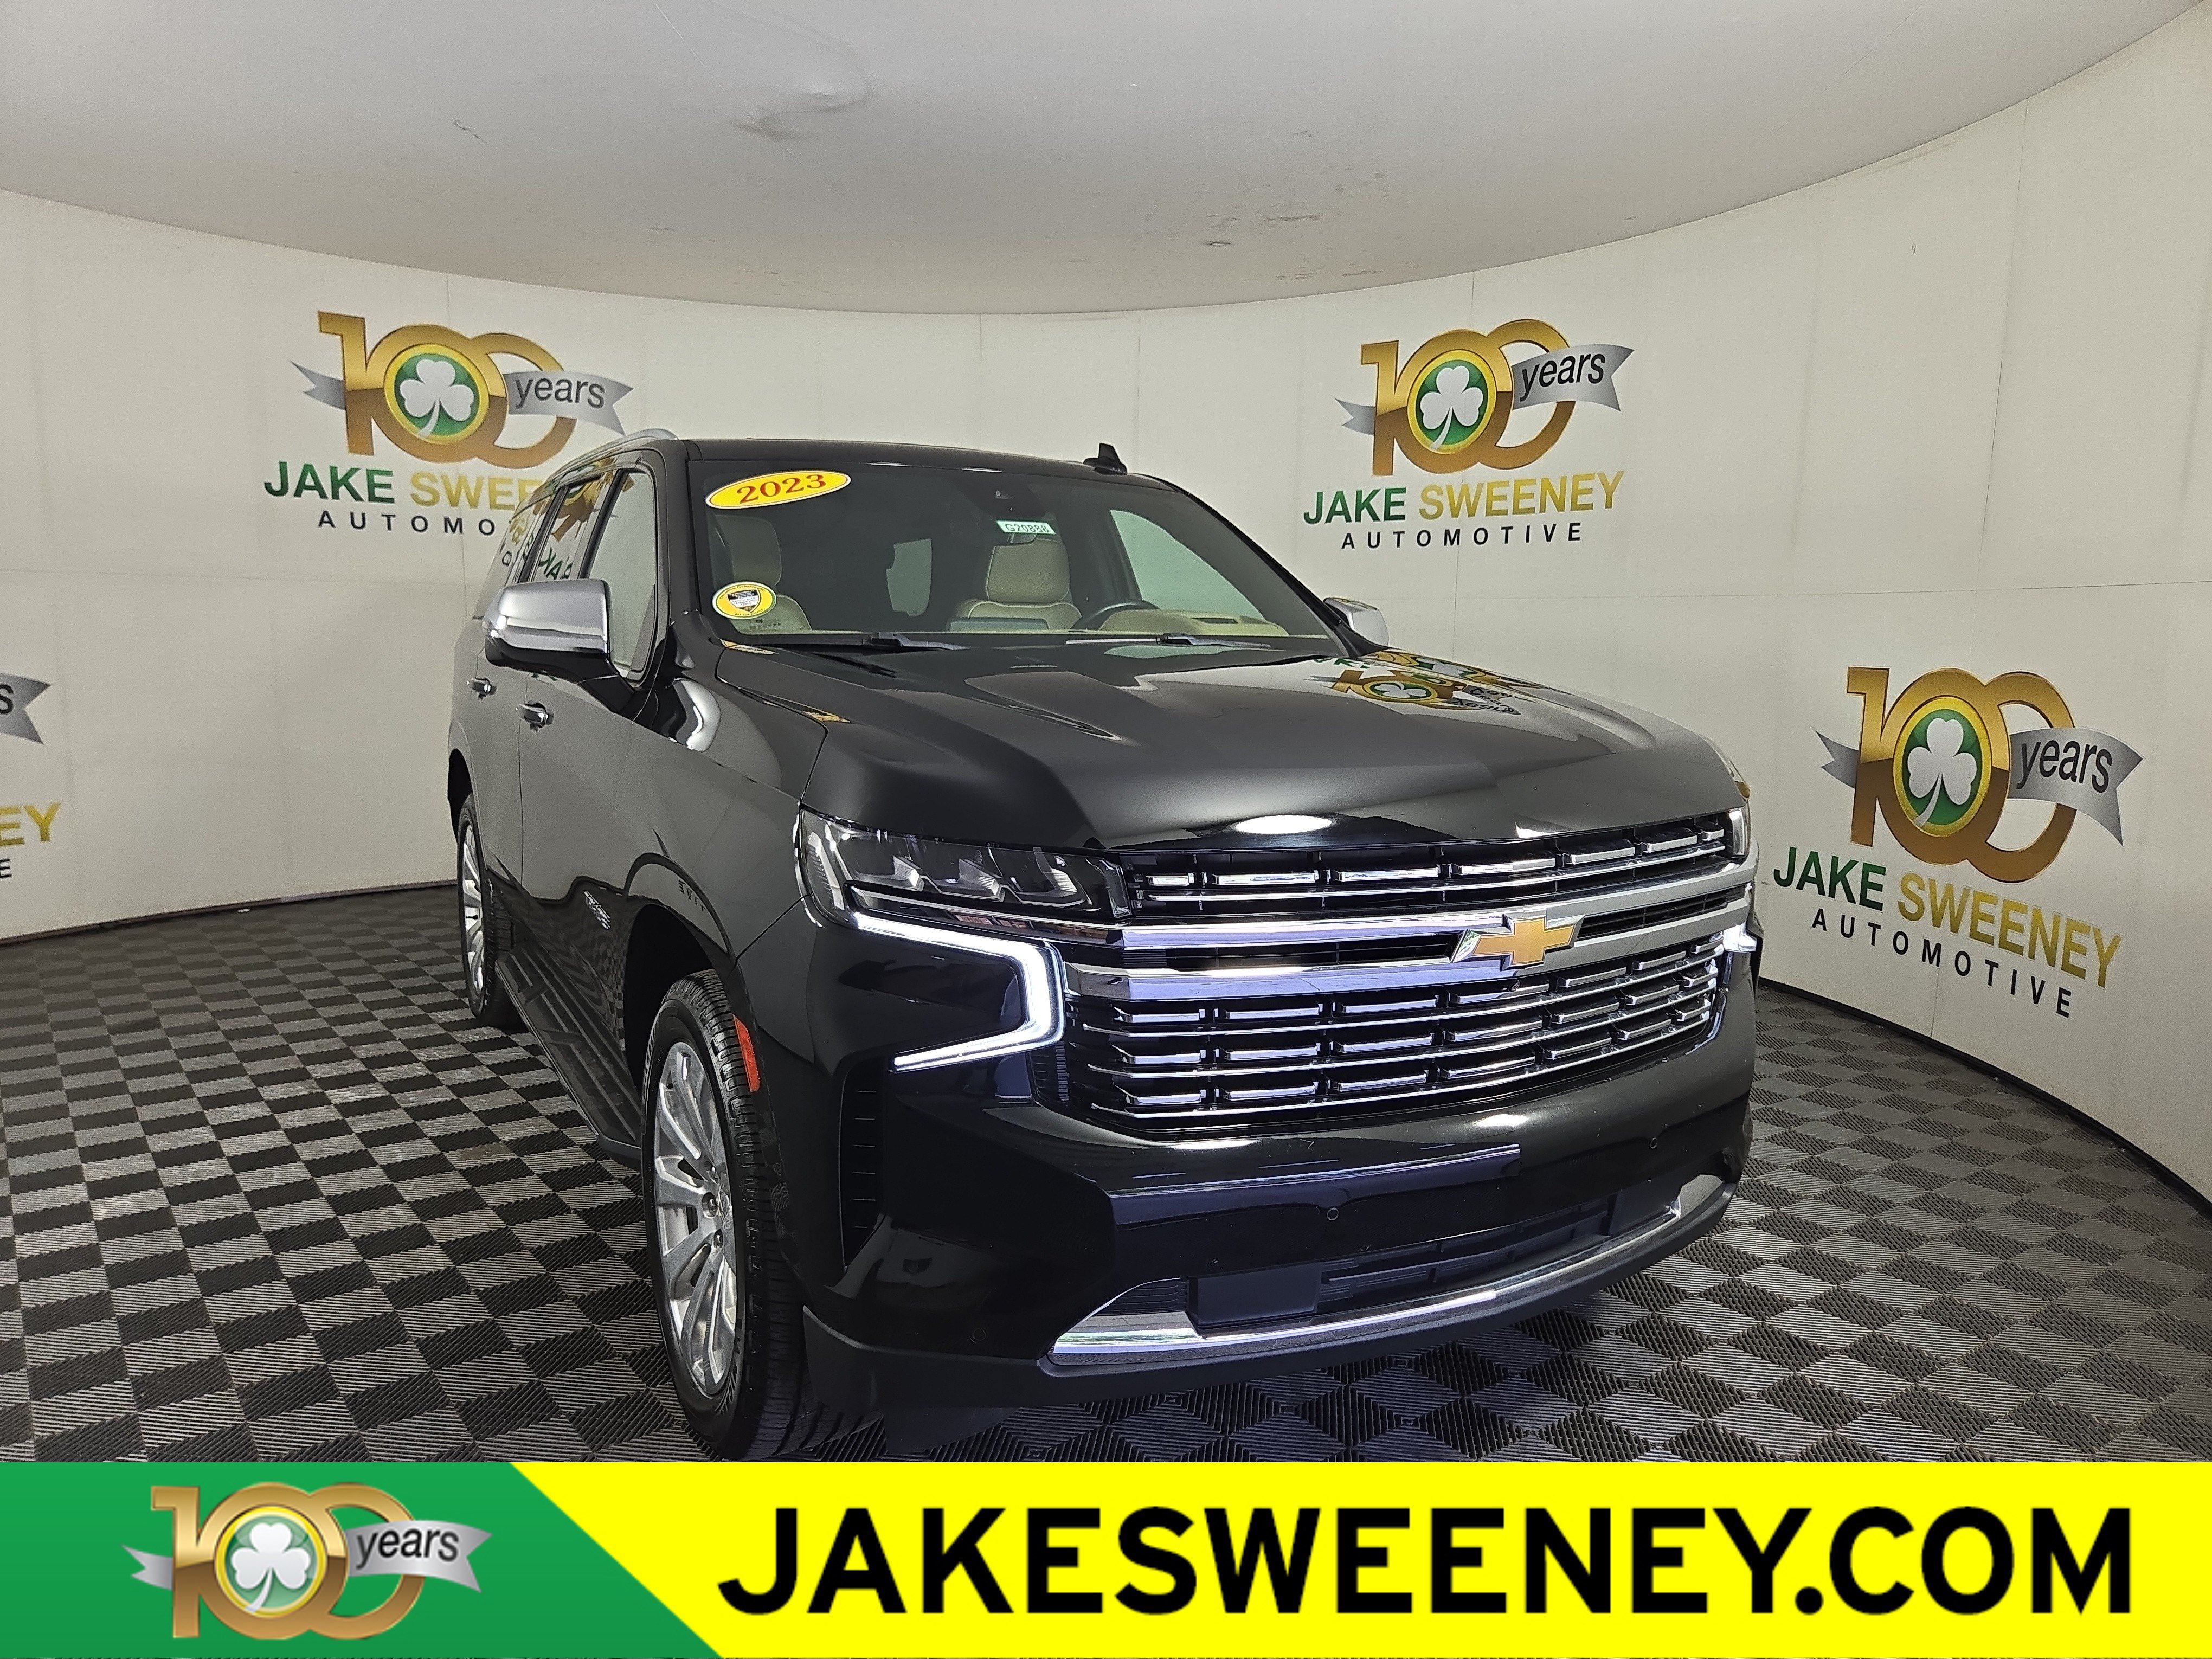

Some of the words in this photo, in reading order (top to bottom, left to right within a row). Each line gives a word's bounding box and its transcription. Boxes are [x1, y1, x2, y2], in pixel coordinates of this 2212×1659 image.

[514, 376, 606, 409] years
[1519, 353, 1606, 402] years
[264, 461, 395, 505] JAKE
[410, 472, 544, 511] SWEE
[736, 474, 826, 504] 2023
[1303, 487, 1407, 525] JAKE
[1418, 470, 1625, 520] SWEENEY
[318, 510, 496, 536] AUTOMO
[1005, 524, 1050, 533] G20888
[1341, 523, 1582, 550] AUTOMOTIVE
[2016, 739, 2112, 793] years
[1773, 847, 1887, 911] JAKE
[1898, 872, 2123, 988] SWEENEY
[1812, 908, 2072, 1018] AUTOMOTIVE
